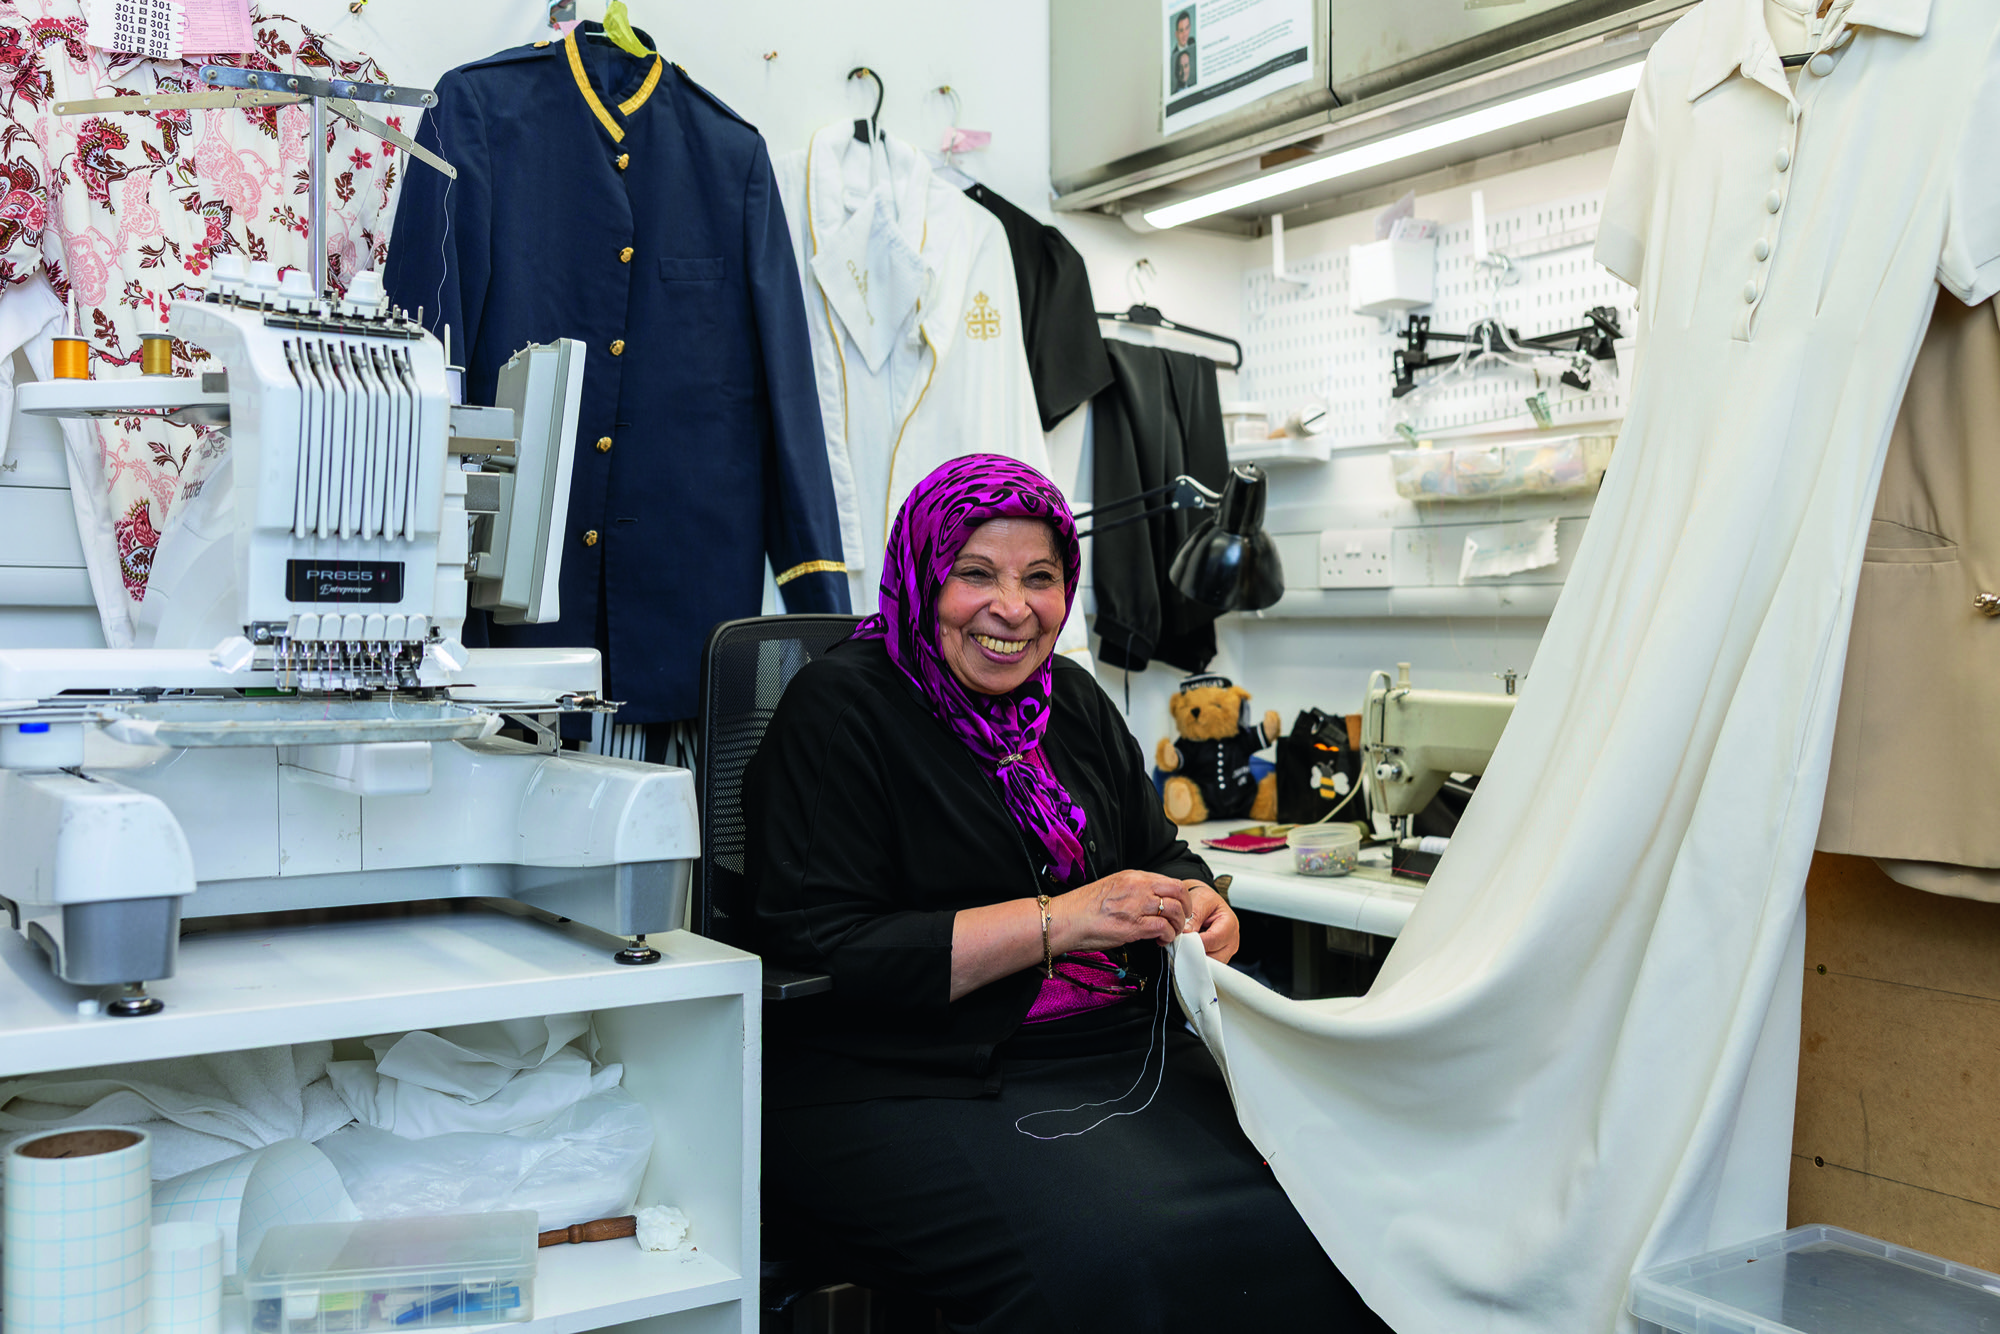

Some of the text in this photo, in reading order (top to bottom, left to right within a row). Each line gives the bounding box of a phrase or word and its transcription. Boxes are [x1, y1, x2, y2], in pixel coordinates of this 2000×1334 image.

[115, 3, 135, 14] 301
[151, 10, 170, 21] 301
[152, 0, 171, 11] 301
[114, 12, 134, 24] 301
[150, 20, 169, 31] 301
[116, 22, 135, 34] 301
[151, 29, 170, 41] 301
[113, 32, 133, 43] 301
[149, 39, 168, 50] 301
[113, 41, 132, 52] 301
[149, 48, 168, 58] 301
[306, 570, 373, 581] PR655
[319, 583, 372, 595] Entrepreneur
